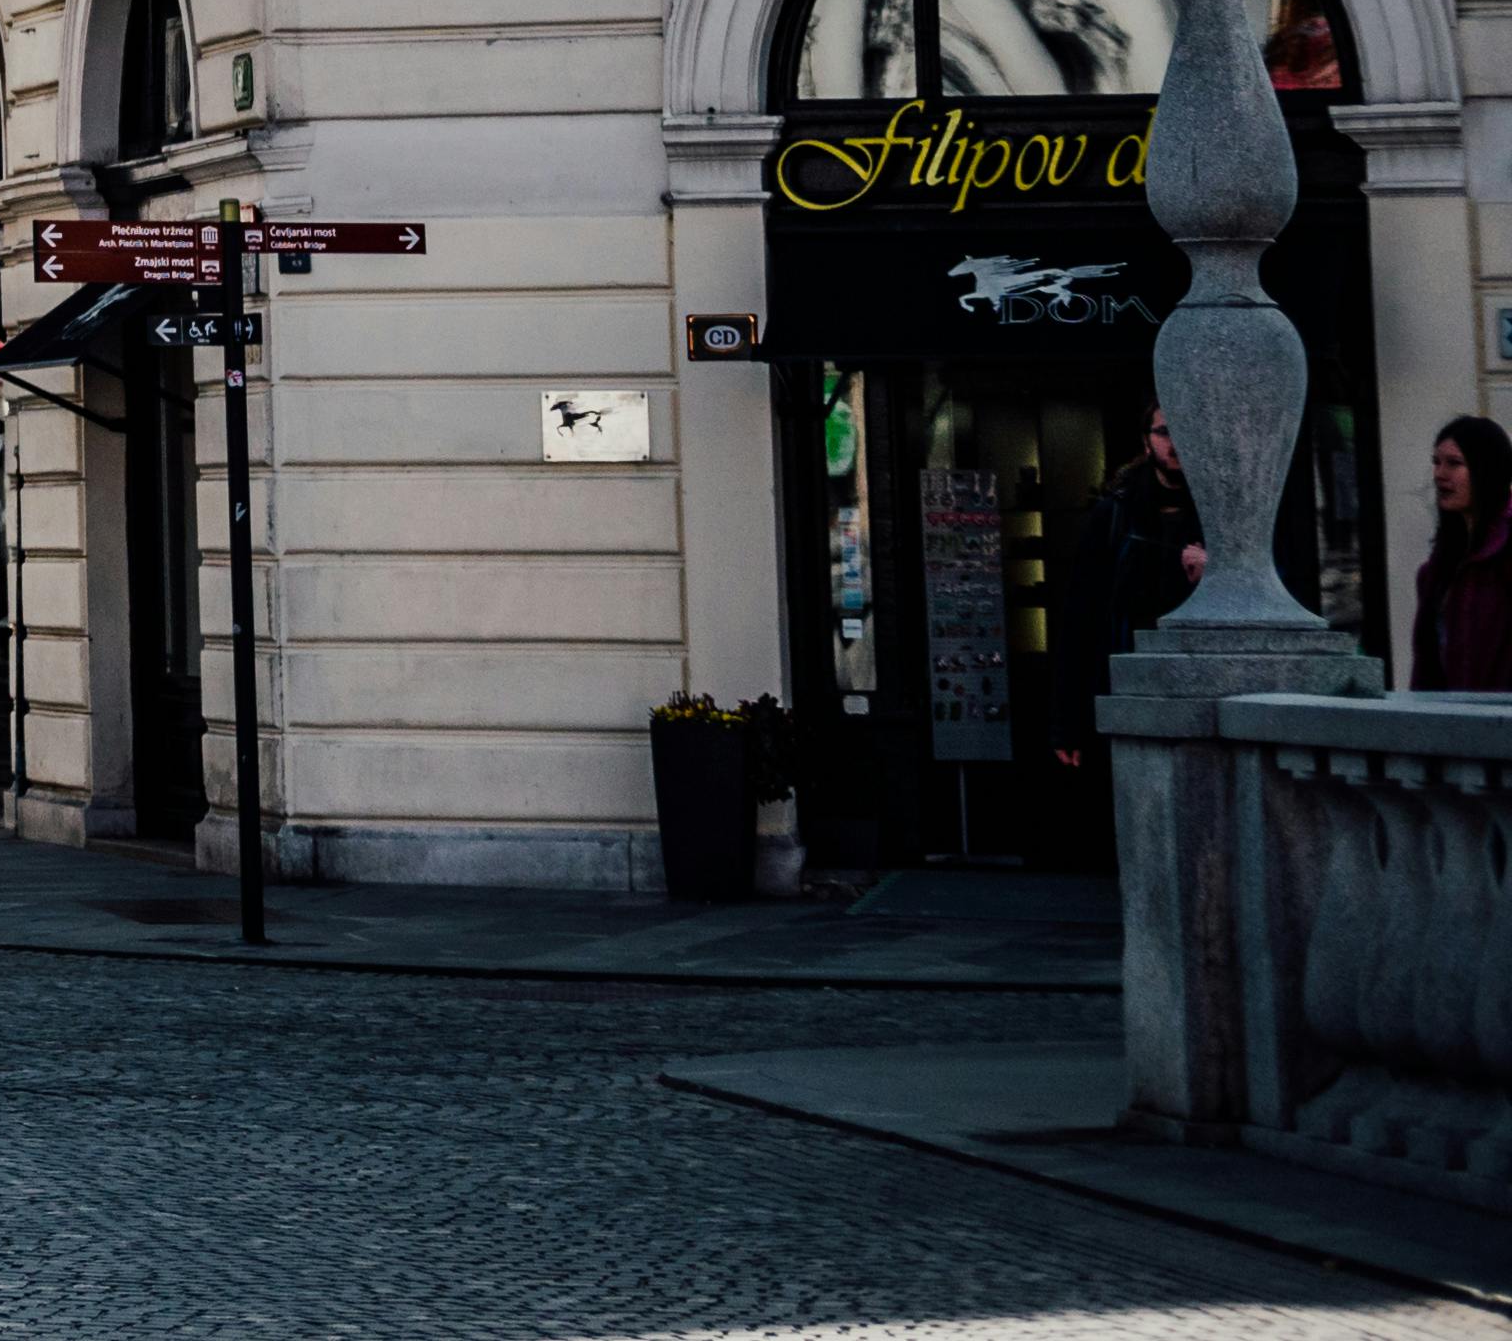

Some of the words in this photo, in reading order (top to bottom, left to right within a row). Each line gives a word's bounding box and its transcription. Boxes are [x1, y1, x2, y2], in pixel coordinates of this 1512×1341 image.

[777, 99, 1088, 214] Filipov
[1106, 105, 1158, 188] d
[111, 225, 160, 236] Plečnikove
[162, 225, 194, 236] tržnice
[269, 225, 312, 238] Čevljarski
[314, 227, 337, 237] most
[304, 241, 327, 250] Bridge
[134, 257, 169, 268] Zmajski
[171, 258, 194, 267] most
[144, 271, 170, 280] Dragon
[171, 271, 195, 280] Bridge
[998, 293, 1161, 324] DOM
[709, 329, 736, 345] CD
